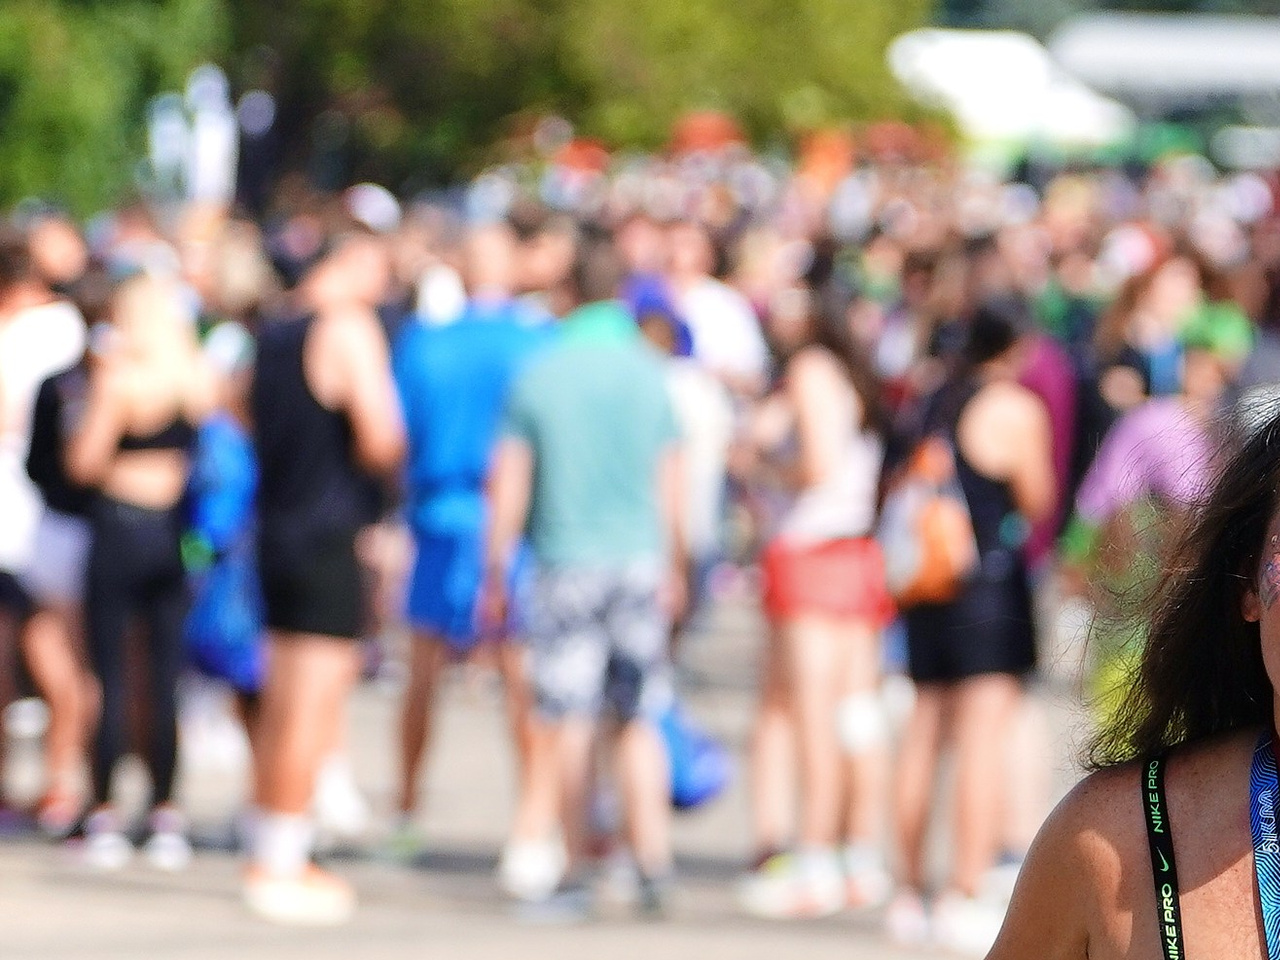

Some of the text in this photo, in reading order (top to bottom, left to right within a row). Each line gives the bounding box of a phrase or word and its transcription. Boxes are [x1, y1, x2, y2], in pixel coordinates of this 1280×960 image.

[1148, 760, 1164, 833] NIKE PRO
[1161, 883, 1175, 923] PRO
